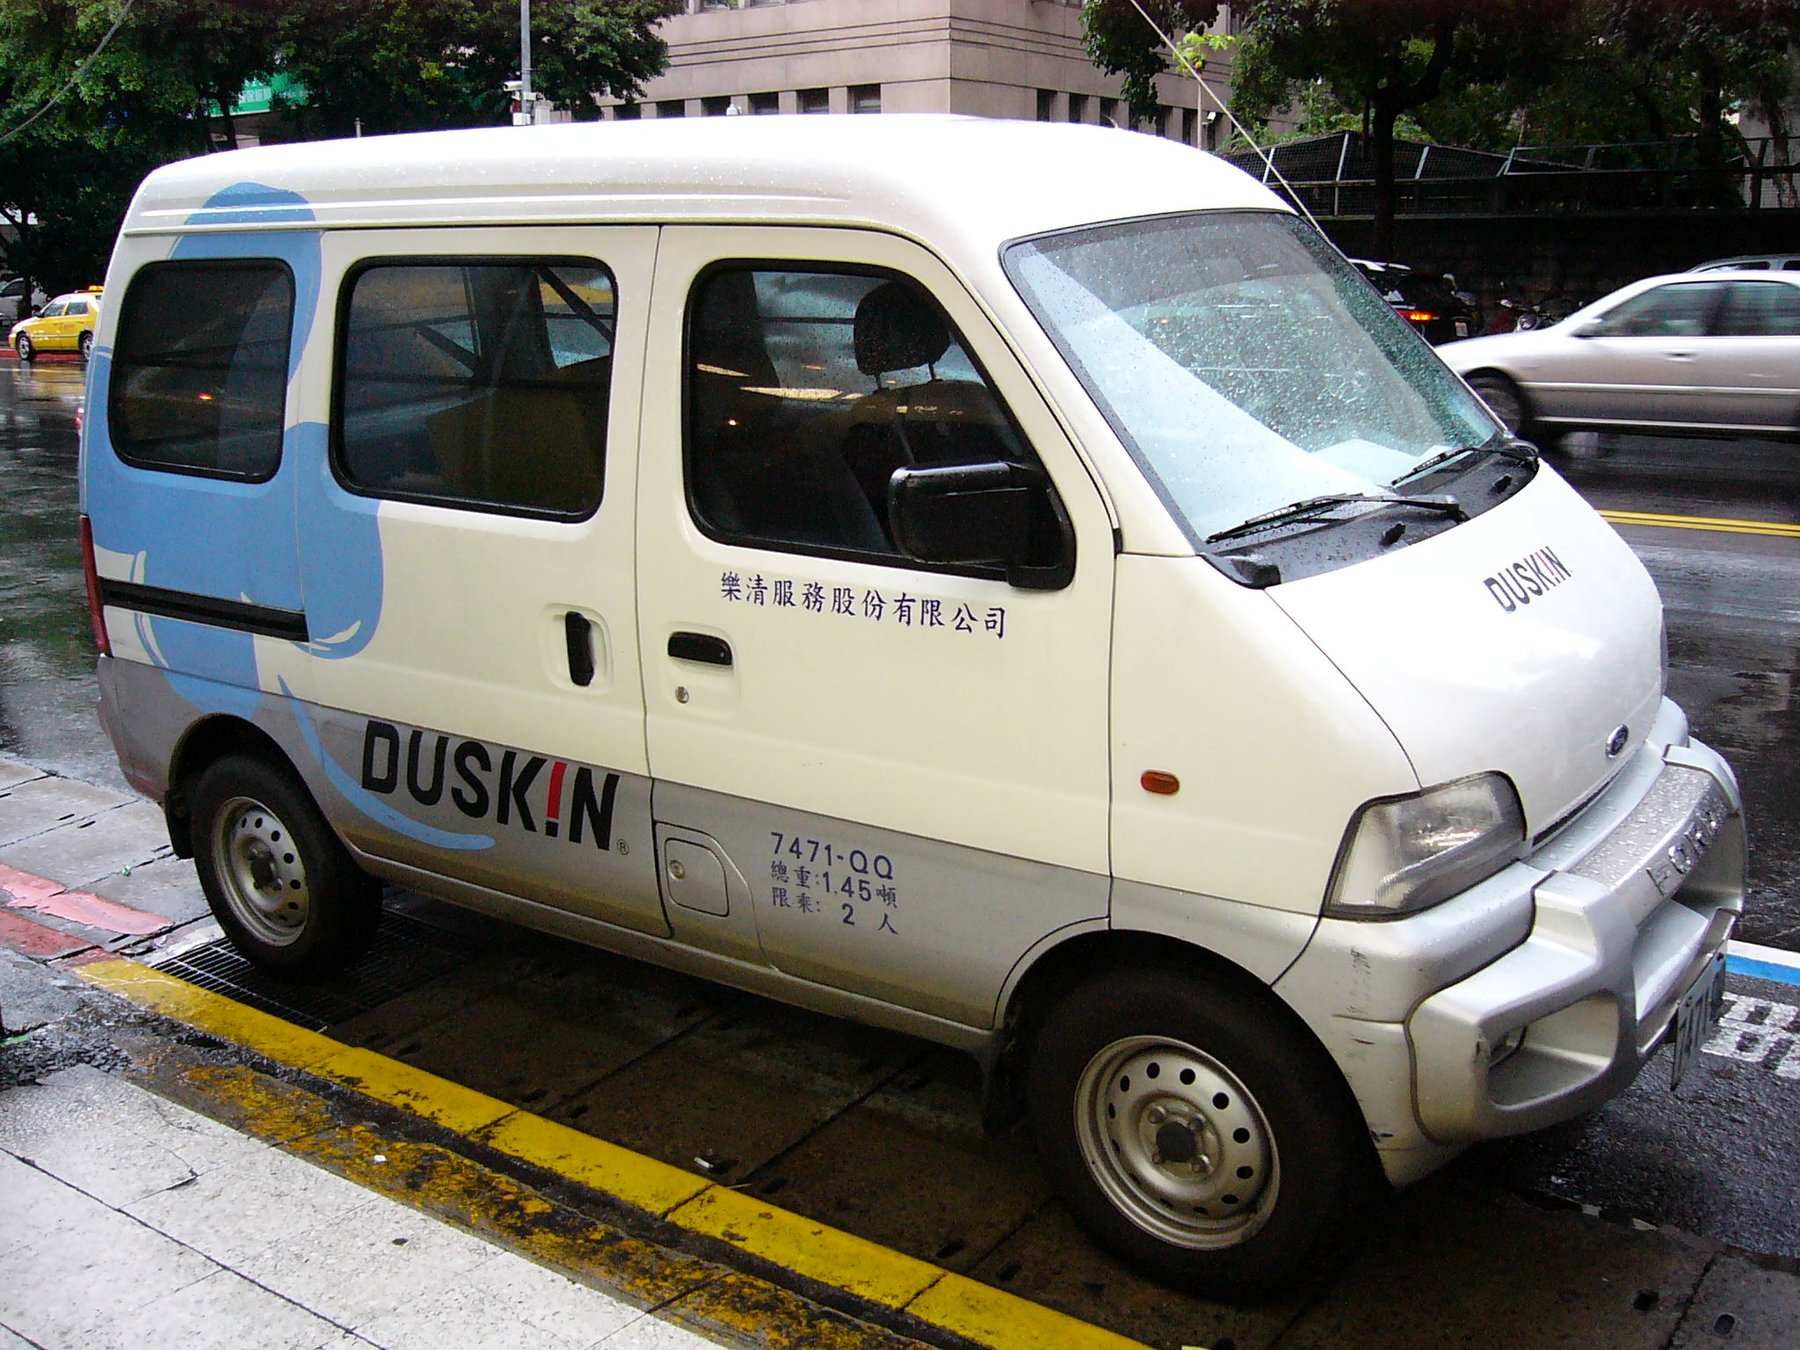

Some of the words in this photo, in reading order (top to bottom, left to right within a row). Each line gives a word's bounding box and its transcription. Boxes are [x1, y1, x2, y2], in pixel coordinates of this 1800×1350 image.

[720, 570, 1007, 639] 樂清服務股份有限公司
[771, 831, 894, 880] 7471-QQ
